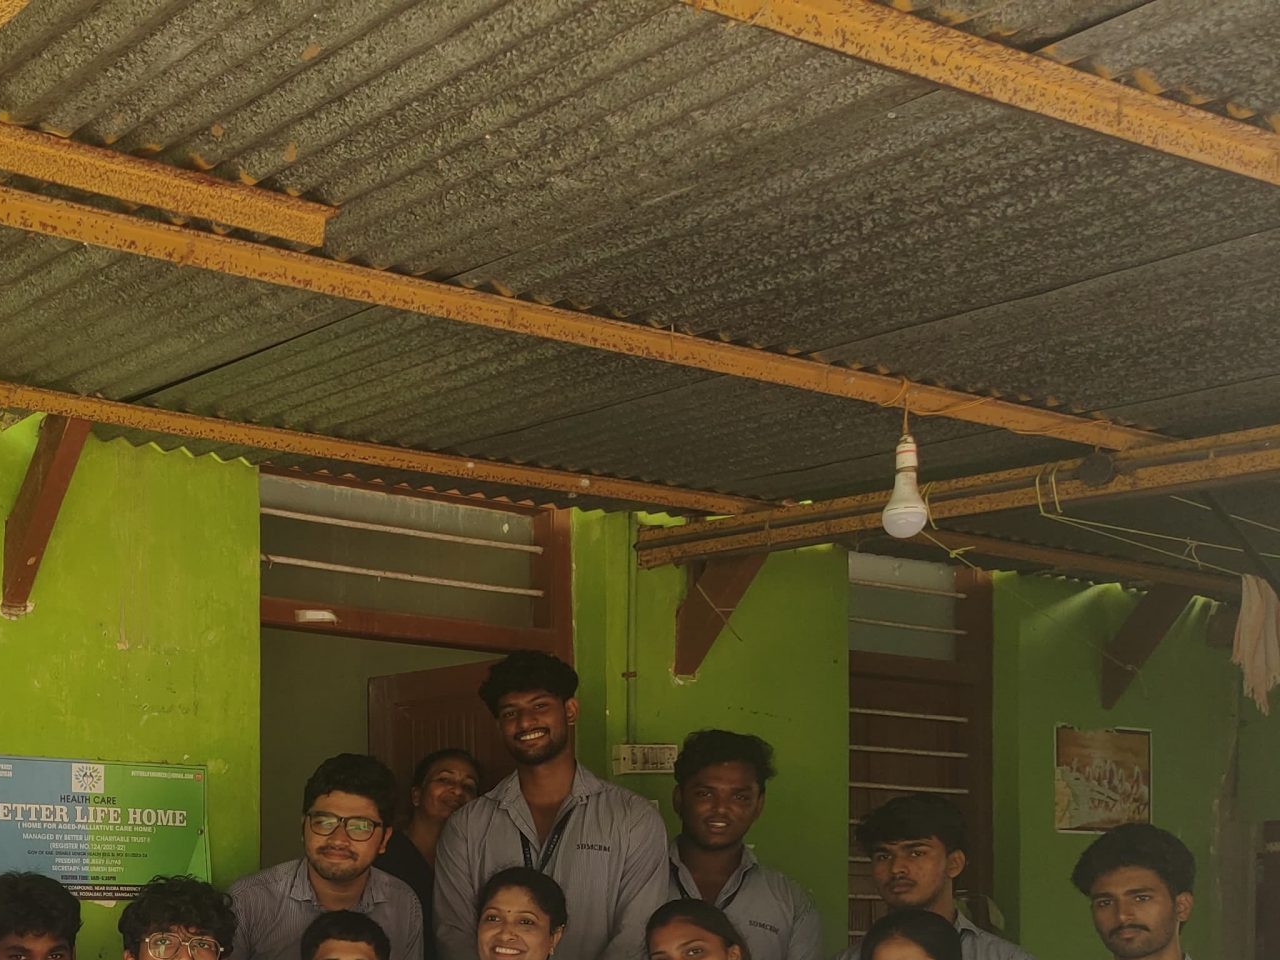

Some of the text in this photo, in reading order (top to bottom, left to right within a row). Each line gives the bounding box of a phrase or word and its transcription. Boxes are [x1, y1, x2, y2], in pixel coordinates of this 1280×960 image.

[60, 794, 116, 806] HEALTH CARE
[75, 807, 122, 825] LIFE
[127, 808, 187, 827] HOME
[43, 822, 57, 830] FOR
[58, 823, 114, 832] AGED-PALLIATIVE
[22, 832, 54, 841] MANAGED
[55, 833, 63, 841] BY
[84, 834, 95, 842] LIFE
[95, 835, 129, 843] CHARITABLE
